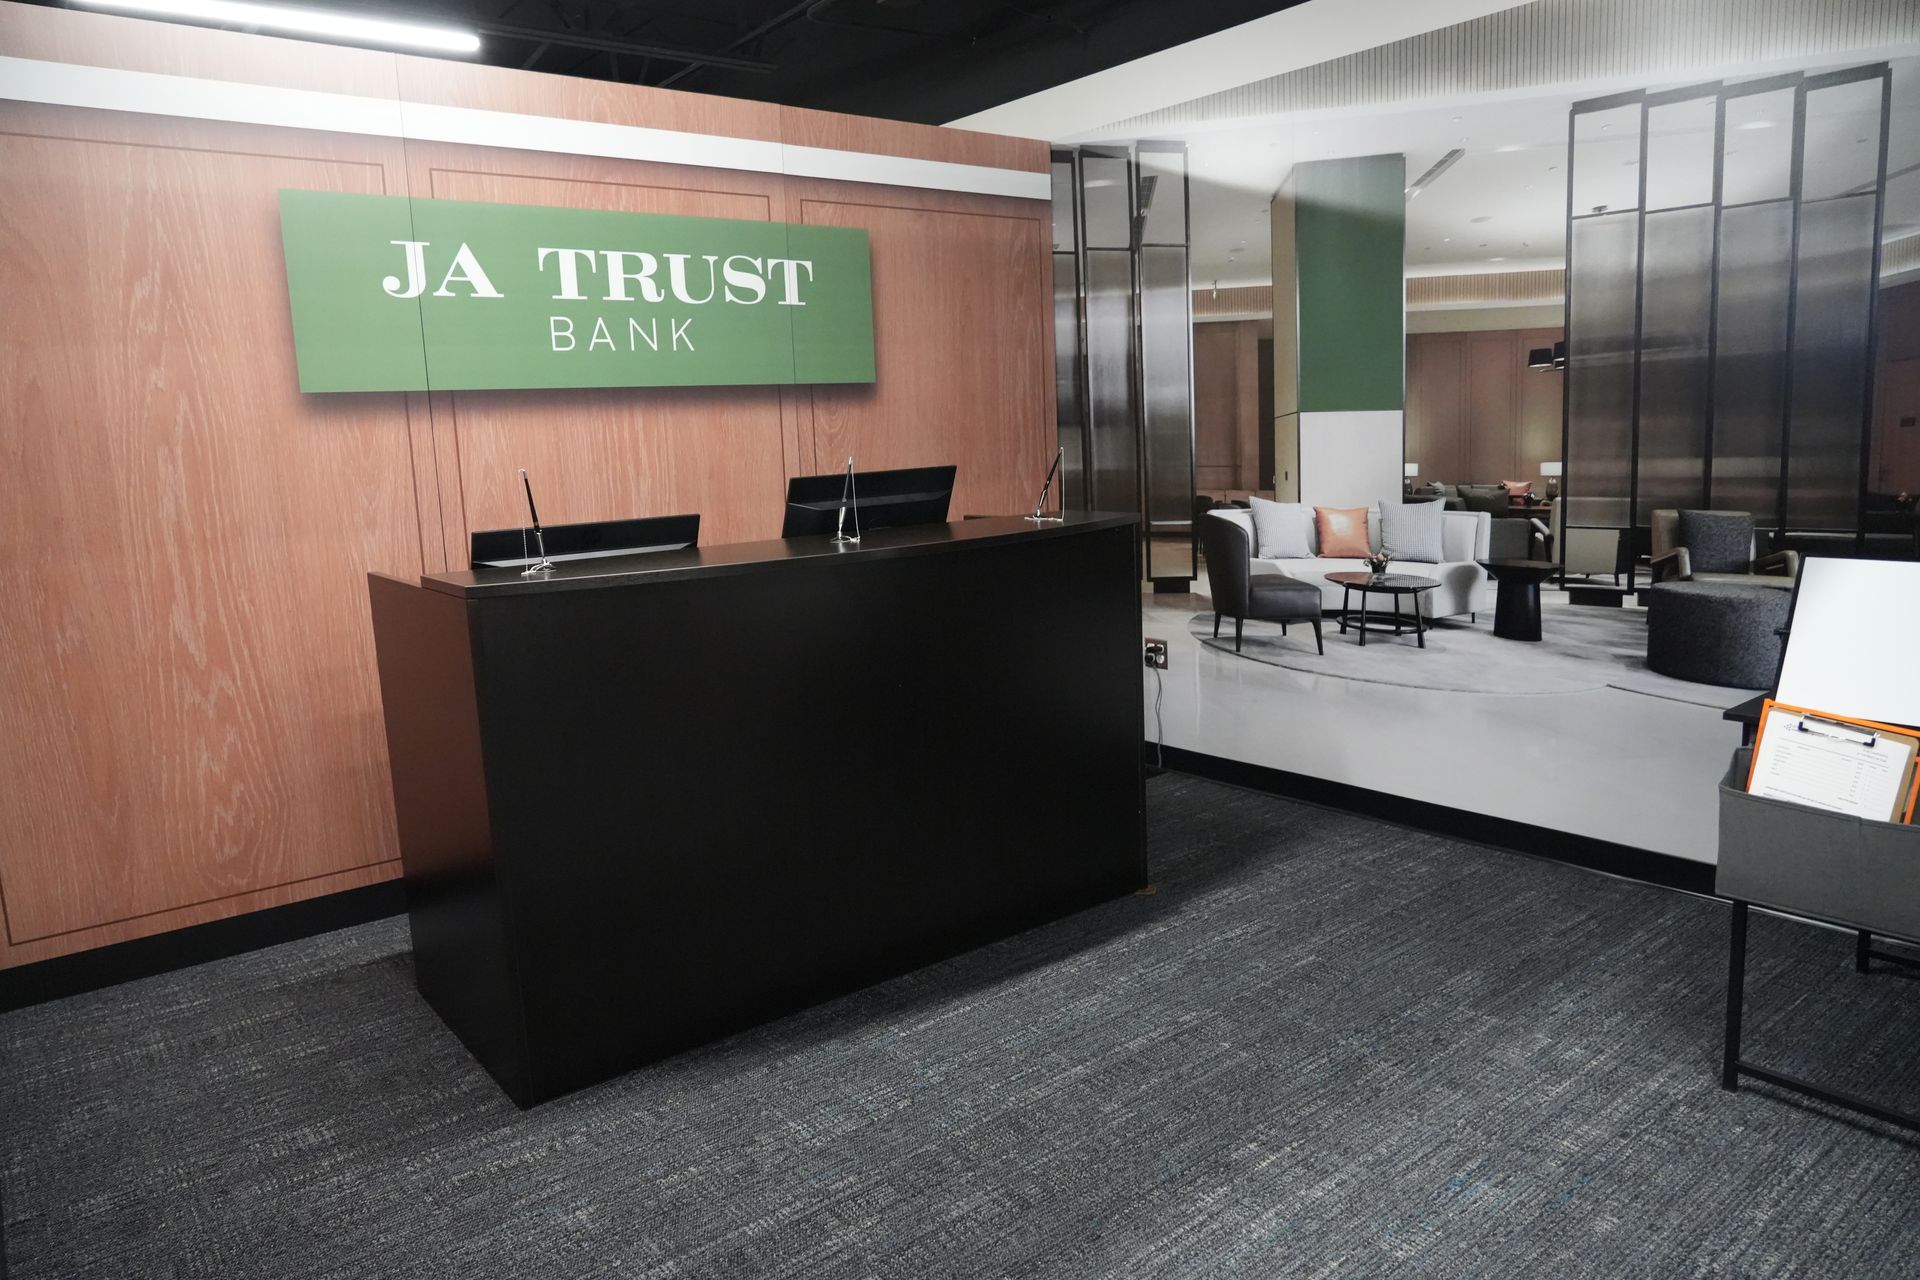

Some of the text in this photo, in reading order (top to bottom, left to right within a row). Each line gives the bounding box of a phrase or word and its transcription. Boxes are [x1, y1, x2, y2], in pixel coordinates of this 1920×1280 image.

[382, 240, 813, 306] JA TRUST
[550, 317, 695, 352] BANK
